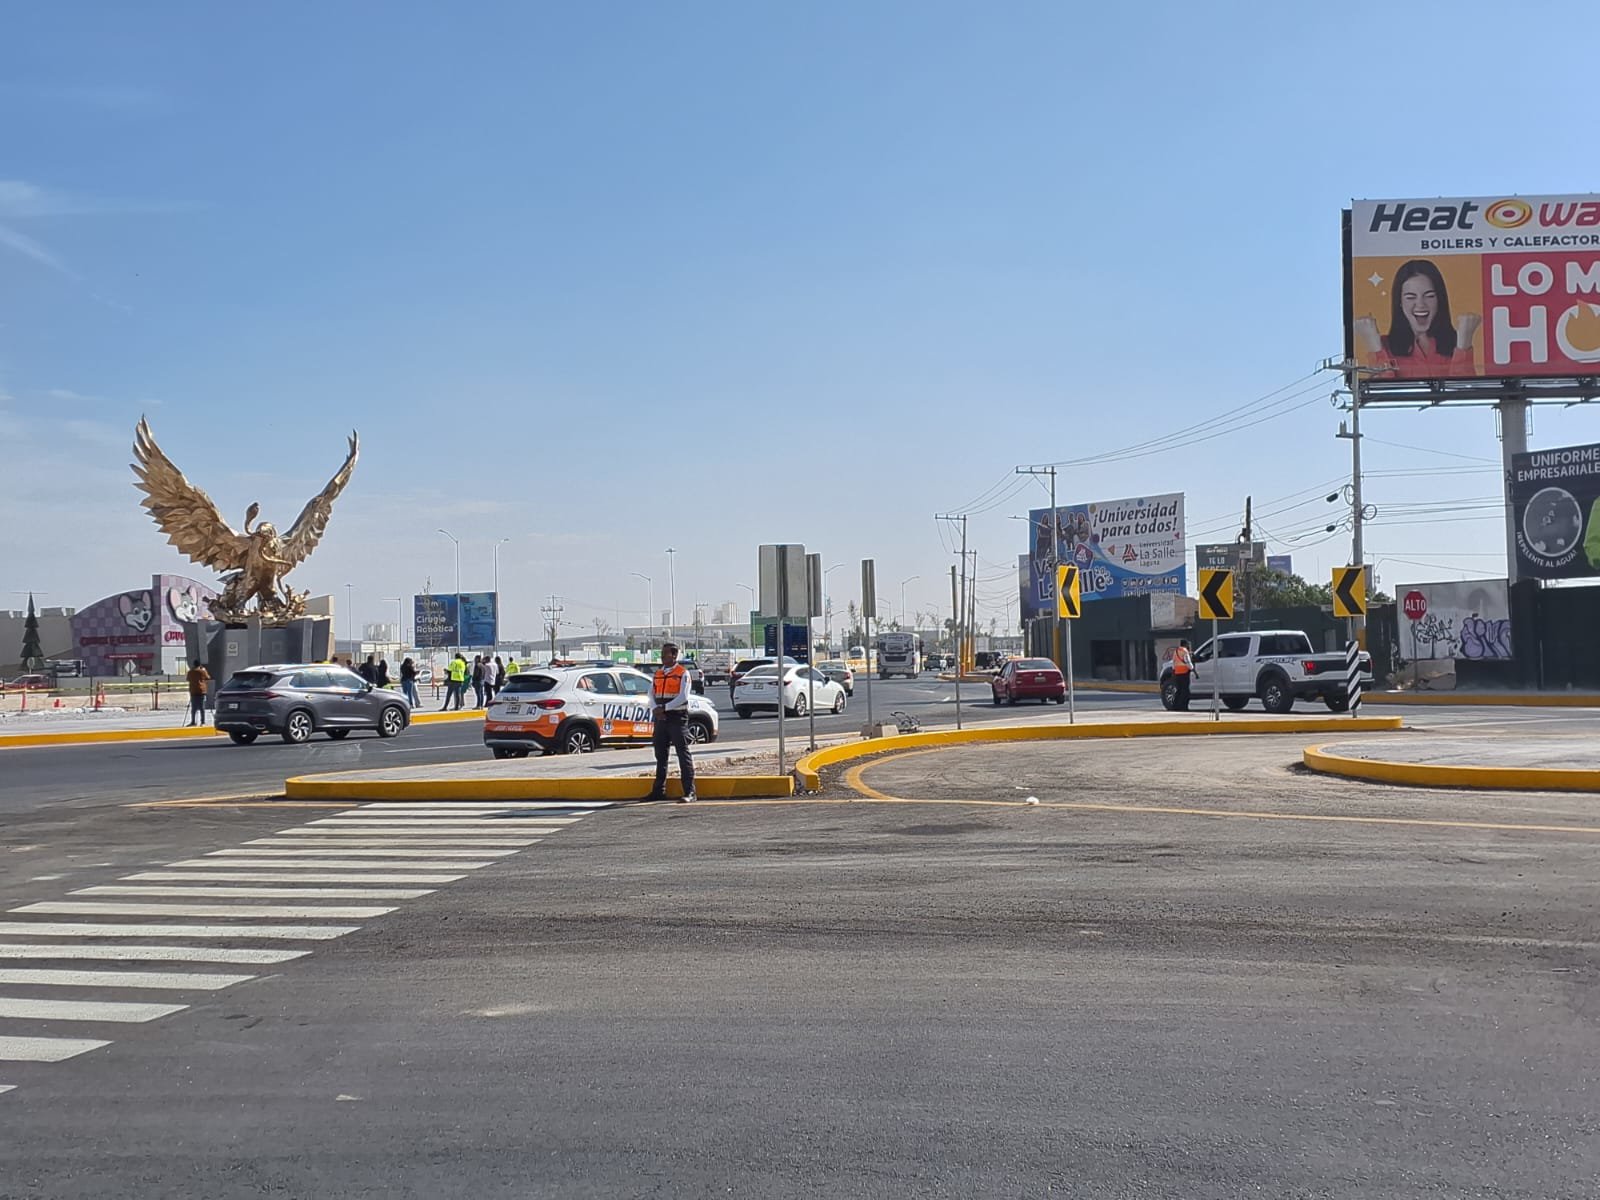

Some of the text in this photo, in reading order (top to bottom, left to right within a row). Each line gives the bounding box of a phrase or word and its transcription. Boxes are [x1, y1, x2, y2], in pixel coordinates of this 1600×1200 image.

[1369, 201, 1479, 232] Heat
[1421, 235, 1600, 250] BOILERS Y CALEFACTOR
[1491, 262, 1553, 296] LO
[1531, 447, 1600, 467] UNIFORME
[1518, 462, 1600, 482] EMPRESARIALE
[1093, 500, 1177, 527] ¡Universidad
[1101, 517, 1177, 542] para todos!
[1139, 539, 1174, 548] Universidad
[1139, 547, 1175, 560] La Salle
[1404, 599, 1426, 611] ALTO
